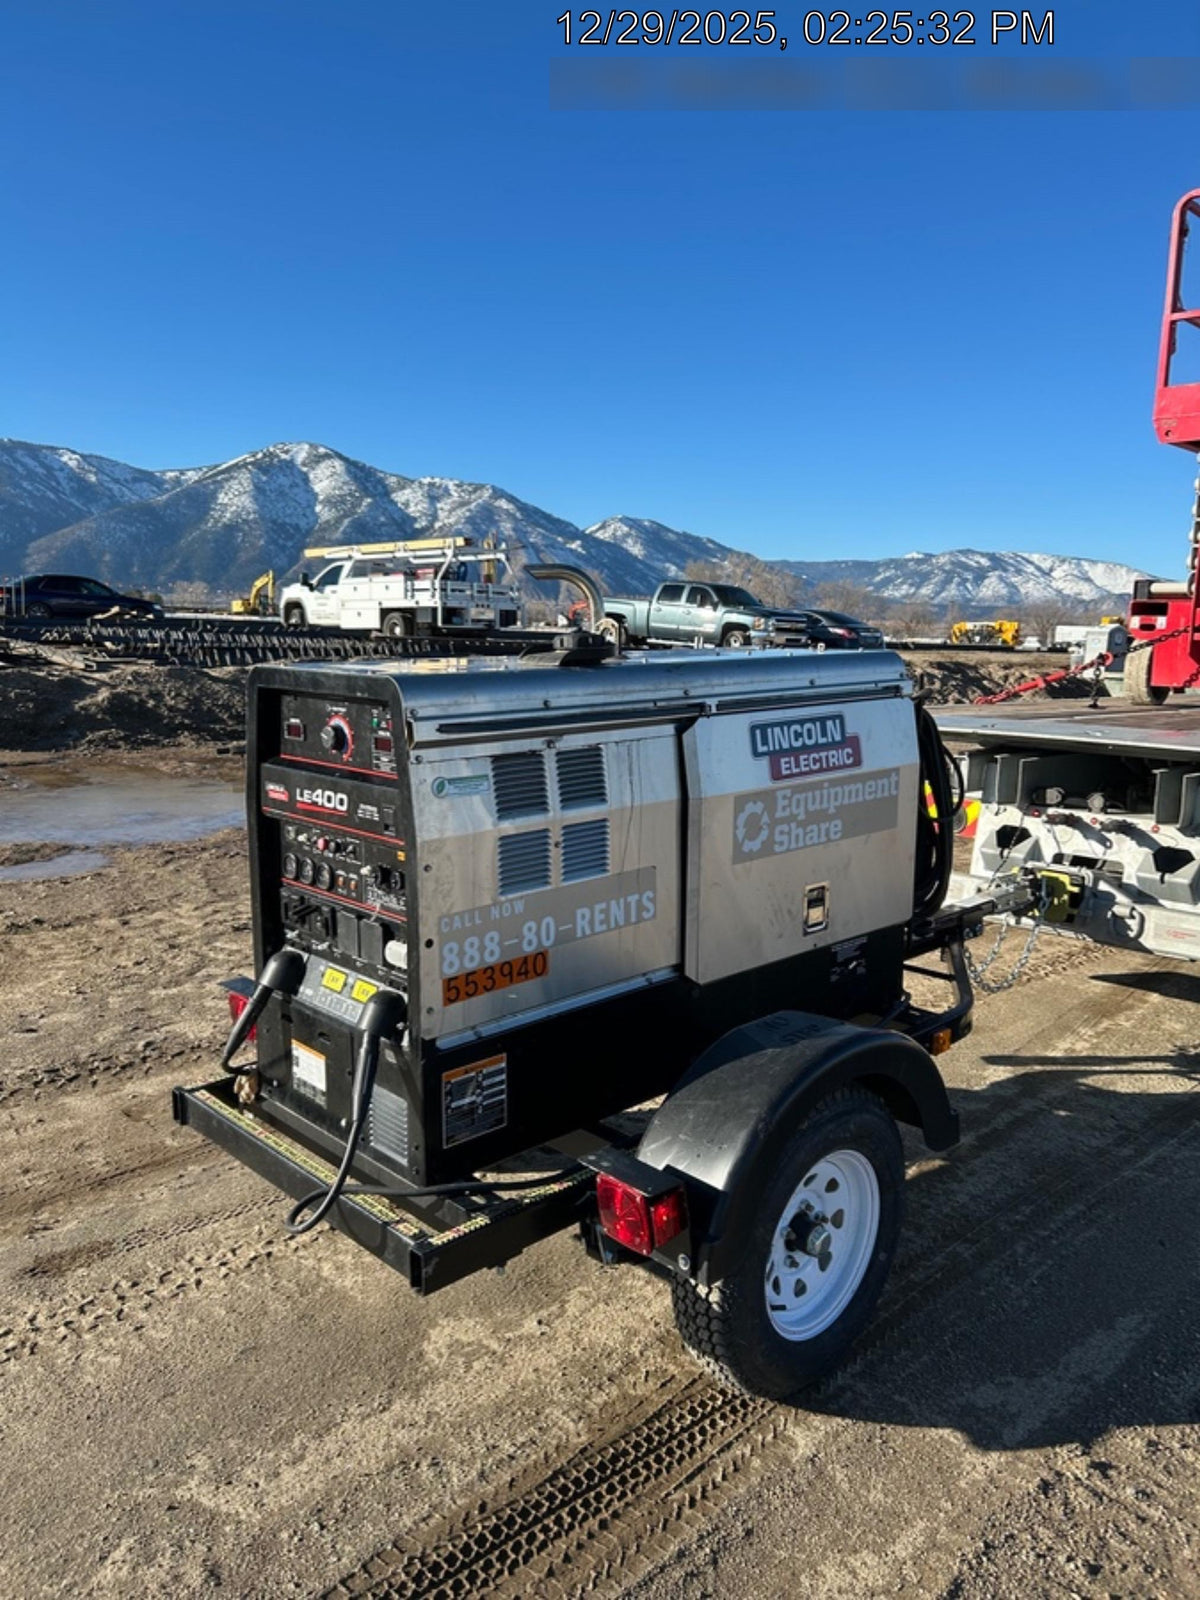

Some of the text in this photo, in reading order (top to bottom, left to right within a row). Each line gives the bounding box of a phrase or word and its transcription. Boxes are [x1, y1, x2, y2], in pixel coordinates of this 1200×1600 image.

[755, 719, 842, 753] LINCOLN
[780, 748, 854, 775] ELECTRIC
[296, 787, 349, 812] LE400
[774, 773, 899, 820] Equipment
[773, 819, 842, 853] Share
[440, 900, 525, 933] CALL NOW
[441, 890, 655, 976] 888-80-RENTS
[446, 952, 548, 1003] 553940
